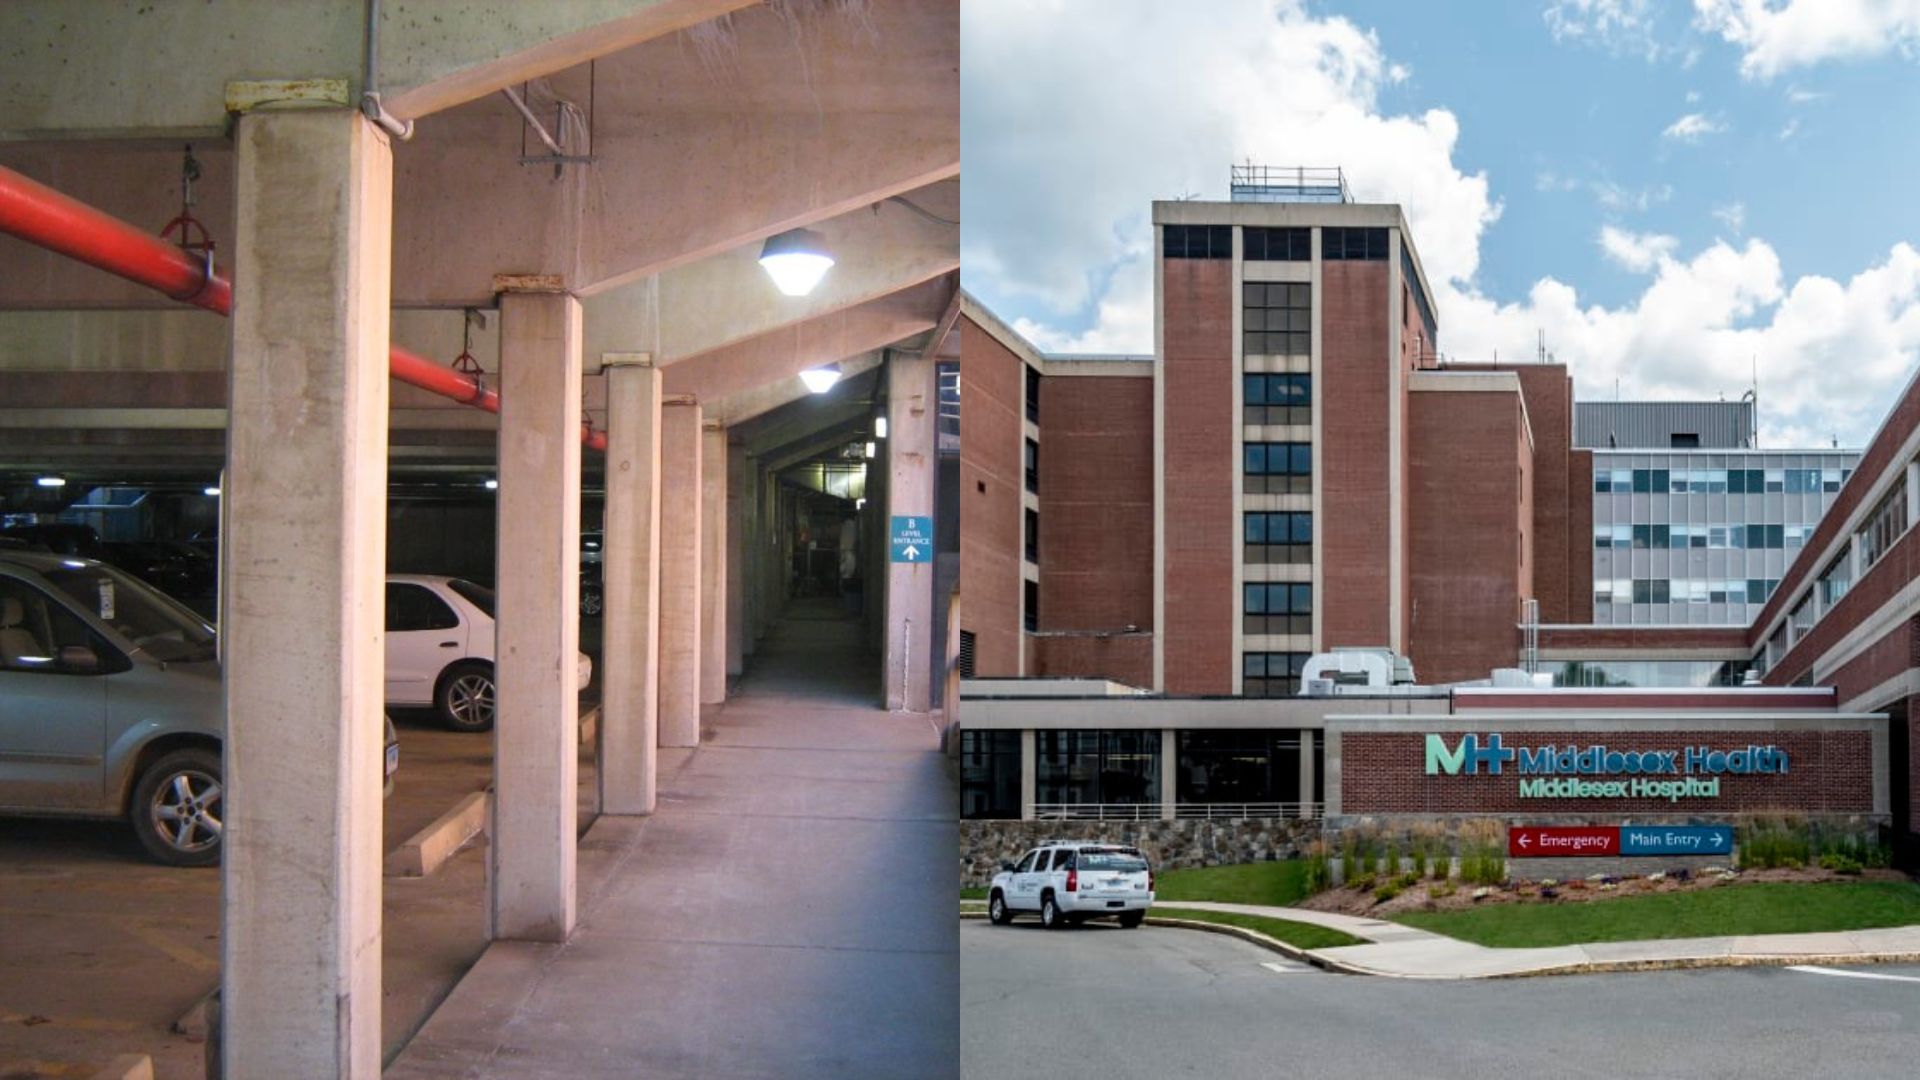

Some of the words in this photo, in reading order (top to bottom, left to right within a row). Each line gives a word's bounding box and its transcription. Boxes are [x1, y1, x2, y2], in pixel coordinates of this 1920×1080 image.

[908, 518, 915, 528] B
[1518, 745, 1680, 774] Middlesex
[1684, 745, 1790, 774] Health
[1519, 777, 1629, 798] Middlesex
[1631, 777, 1720, 803] Hospital
[1539, 834, 1611, 850] Emergency
[1630, 833, 1662, 846] Main
[1665, 833, 1702, 848] Entry
